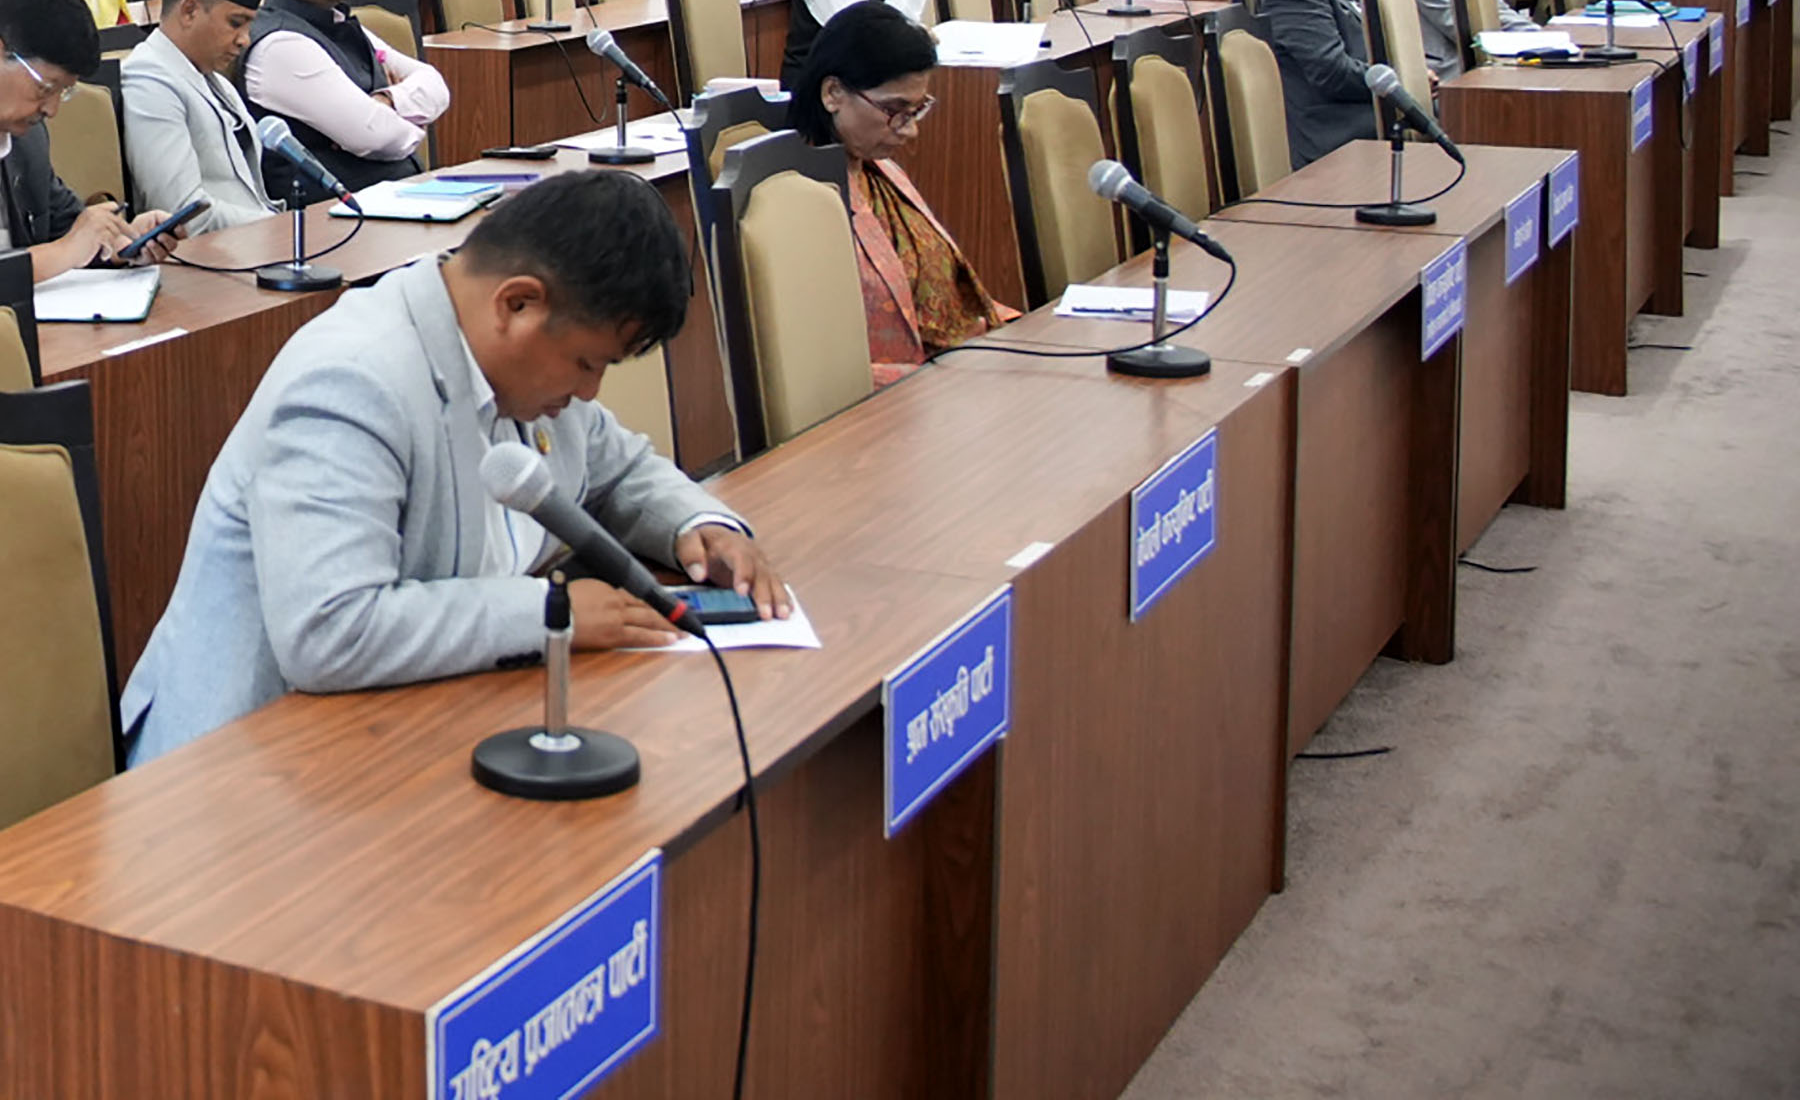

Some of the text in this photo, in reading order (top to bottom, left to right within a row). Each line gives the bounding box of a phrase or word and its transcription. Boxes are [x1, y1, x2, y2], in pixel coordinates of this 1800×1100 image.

[971, 644, 994, 703] पार्टी
[524, 963, 606, 1076] प्रजातन्त्र
[608, 918, 648, 998] पार्टी
